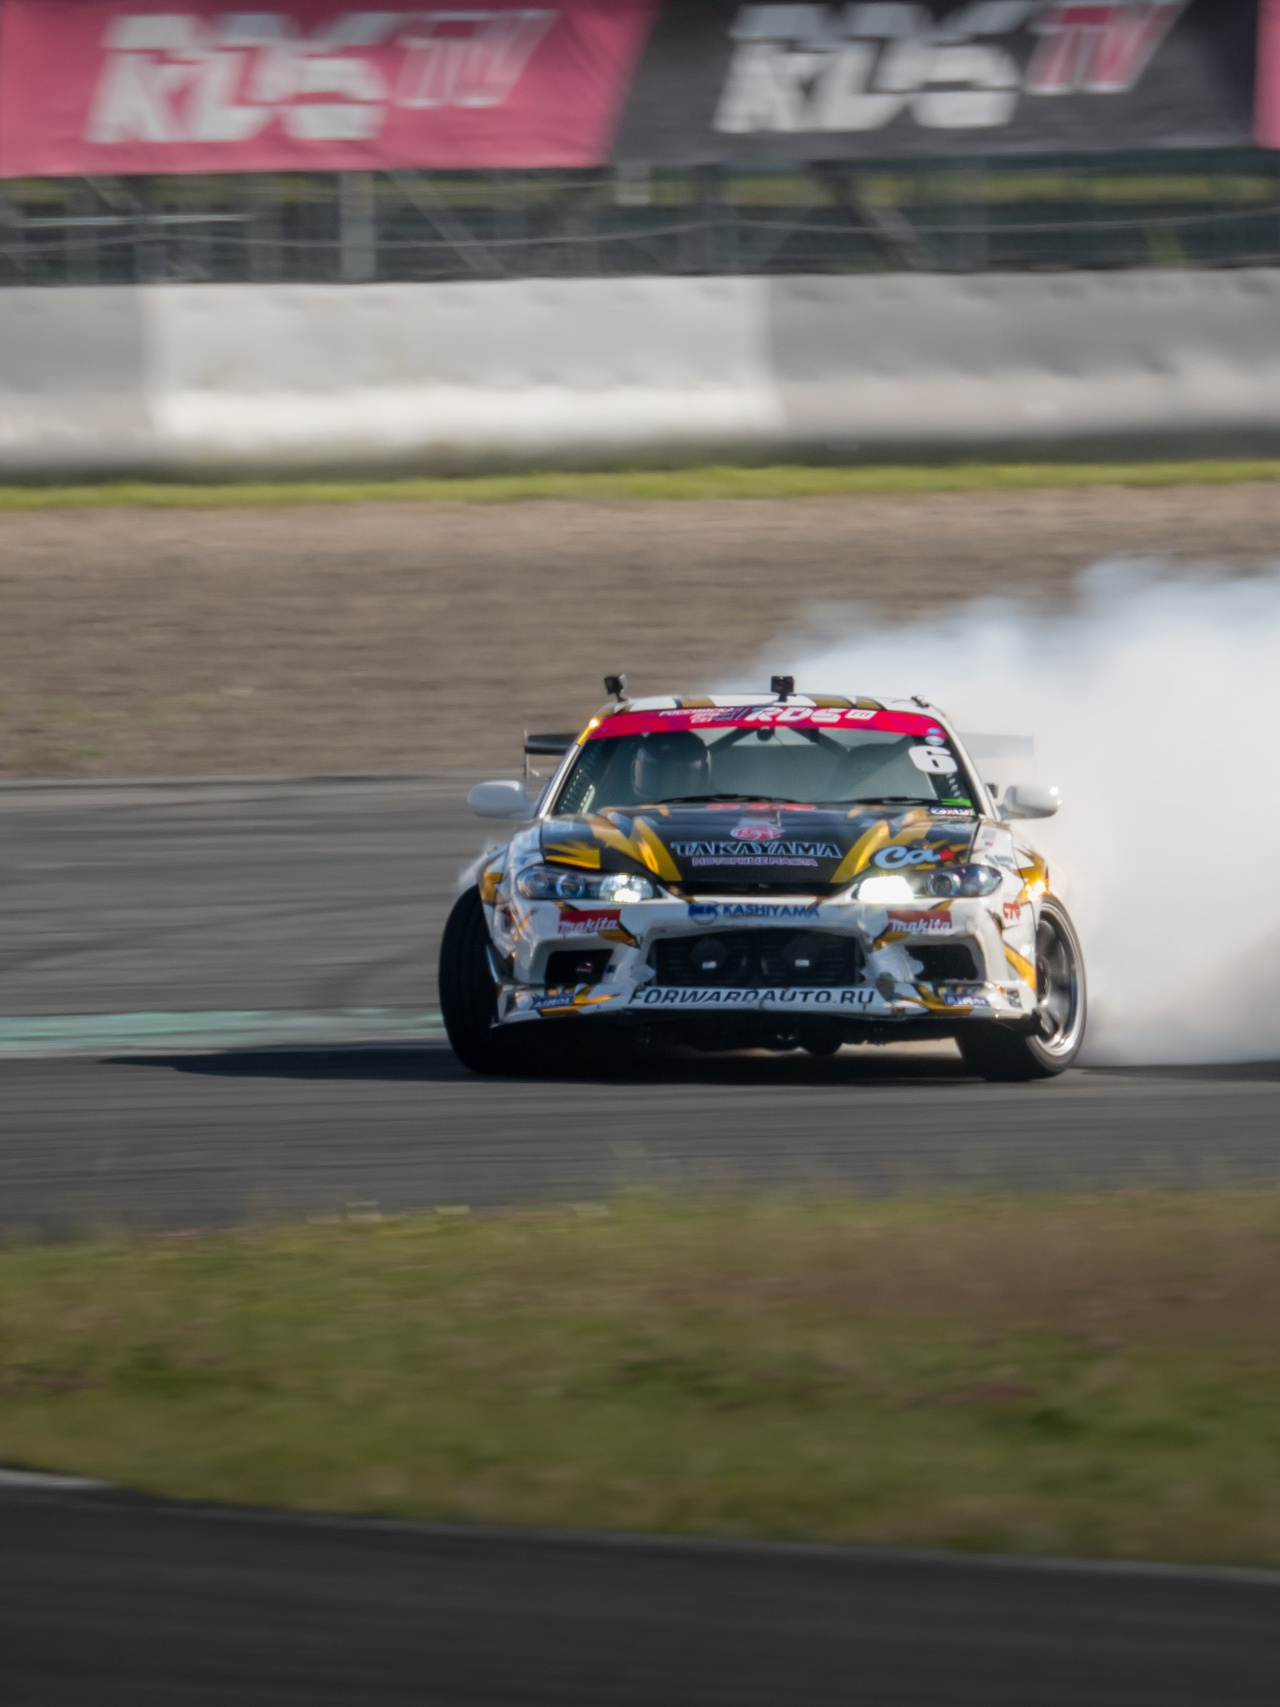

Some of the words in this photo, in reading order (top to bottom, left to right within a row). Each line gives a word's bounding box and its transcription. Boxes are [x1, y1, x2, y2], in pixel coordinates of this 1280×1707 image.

[744, 706, 849, 723] RDS
[908, 745, 958, 774] 6
[671, 841, 843, 859] TAKAYAMA
[723, 904, 820, 918] KASHIYAMA
[628, 989, 875, 1004] FORWARDAUTO.RU
